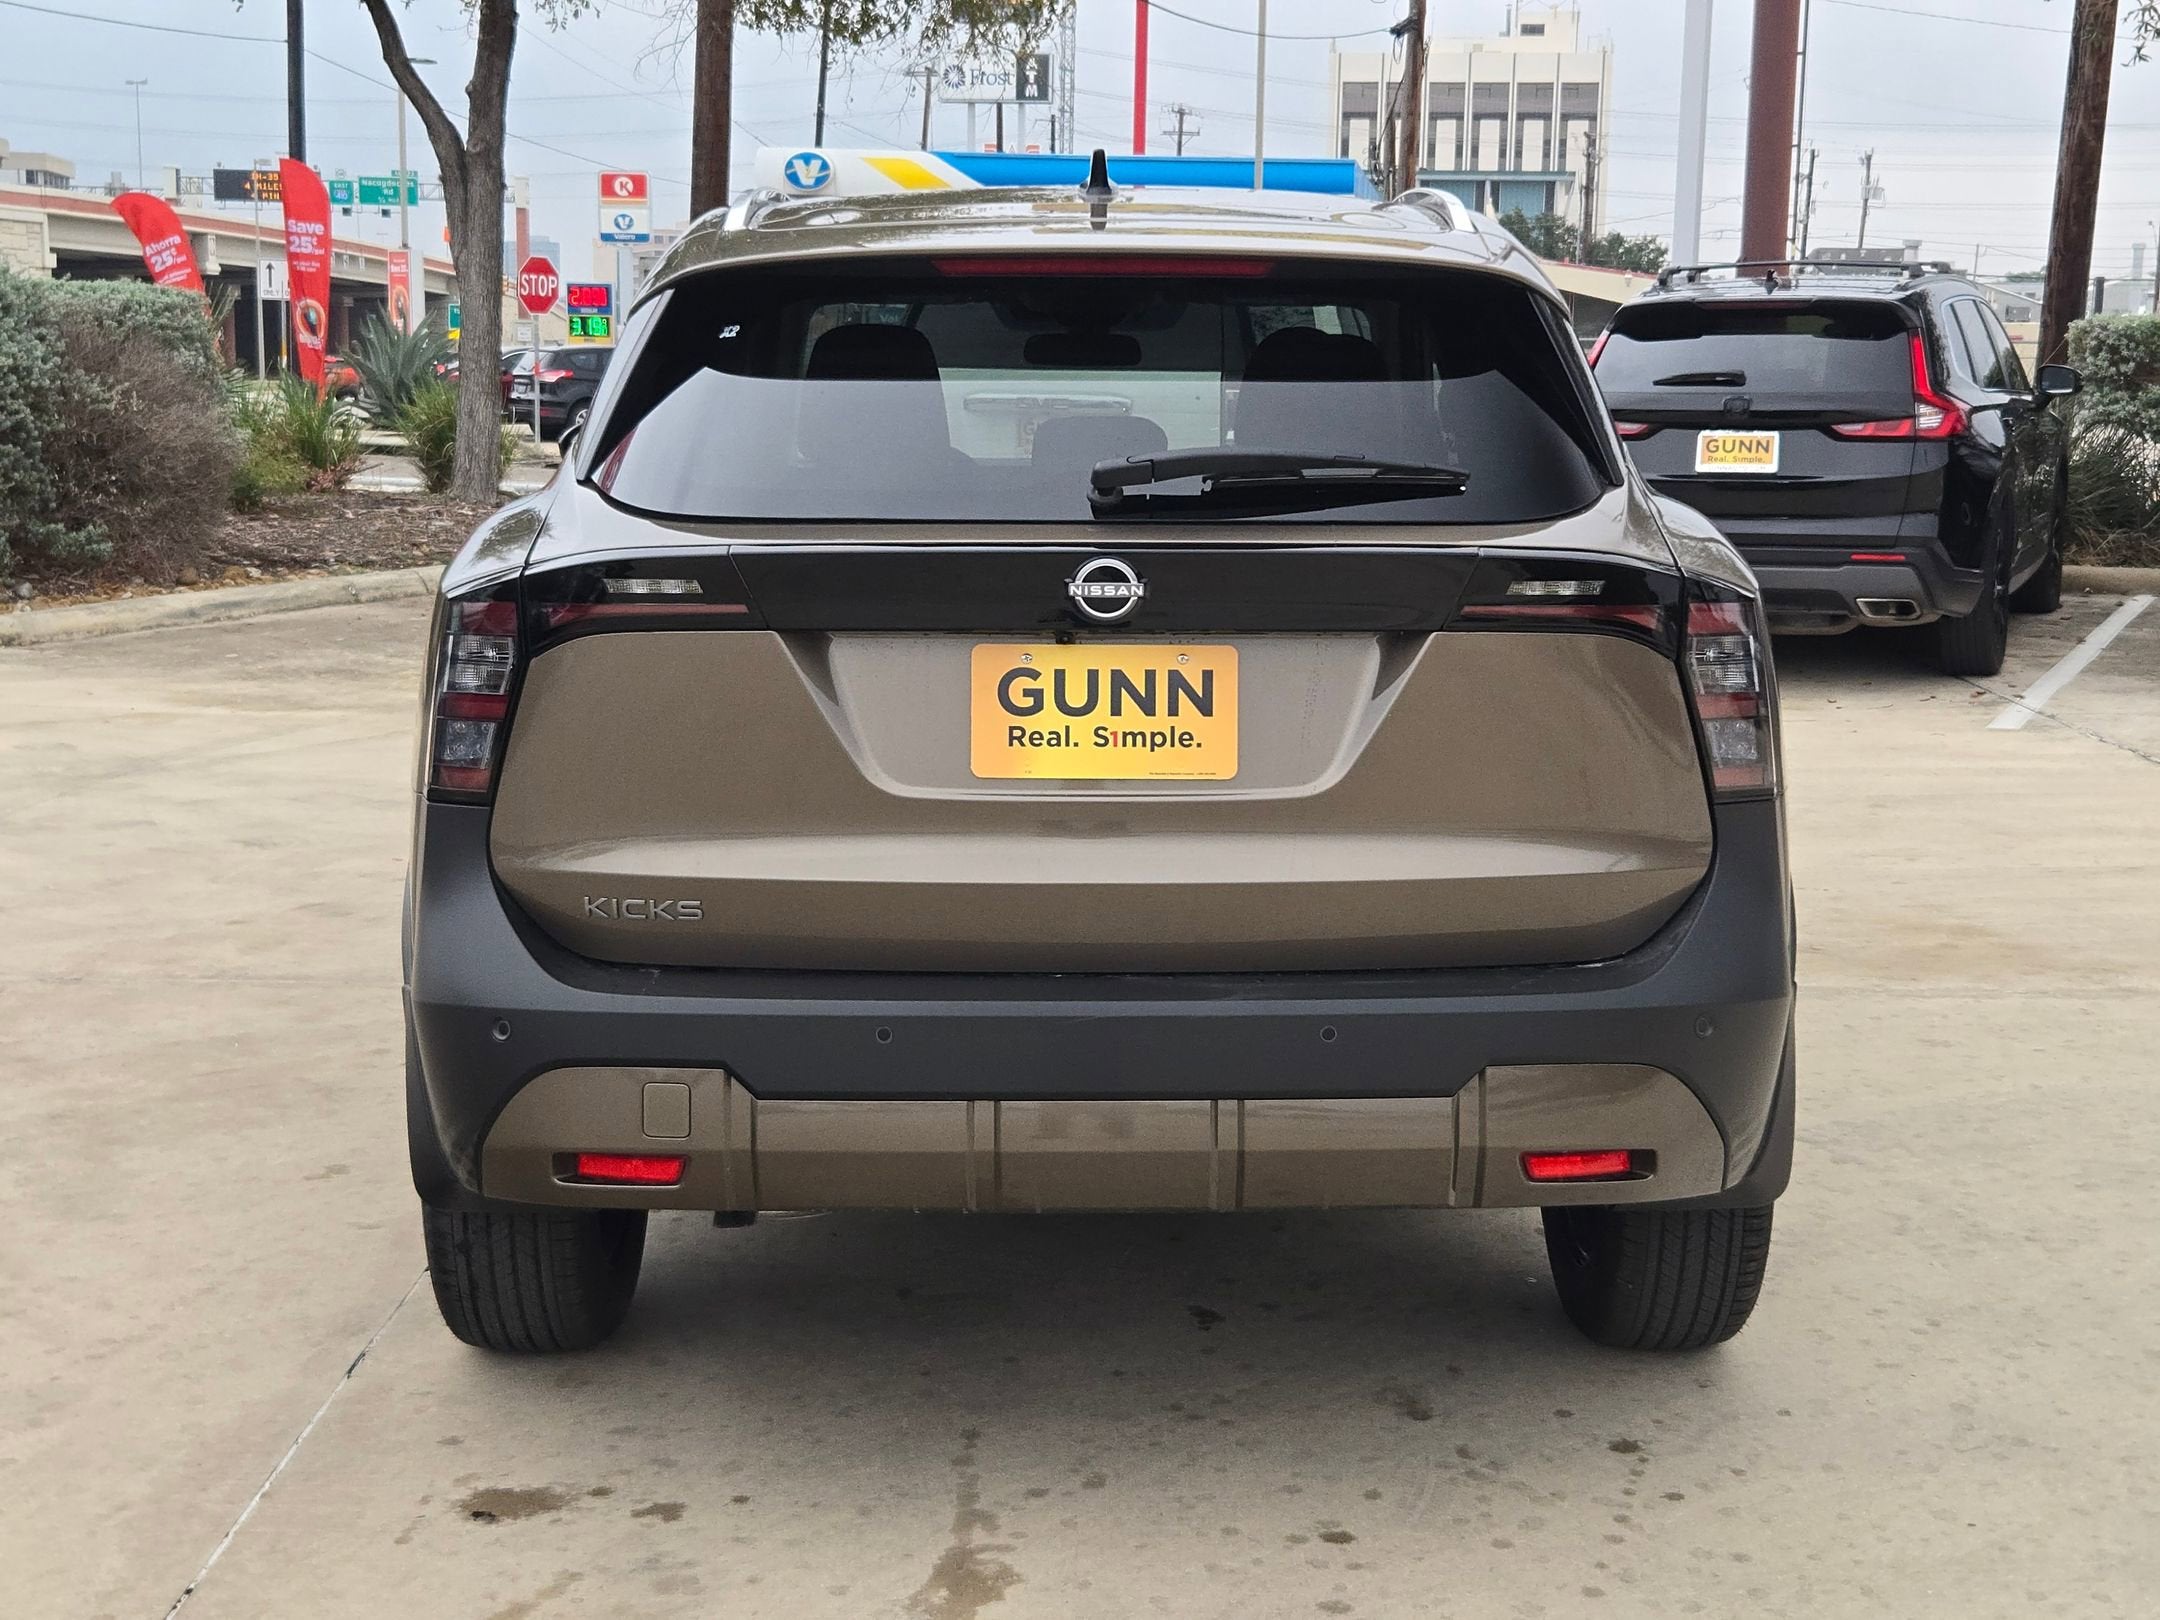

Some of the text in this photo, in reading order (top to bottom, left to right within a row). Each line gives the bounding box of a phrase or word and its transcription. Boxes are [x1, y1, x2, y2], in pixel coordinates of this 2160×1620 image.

[970, 68, 1014, 86] Frost
[1025, 57, 1039, 97] ATM
[361, 180, 414, 188] Nacogdoces
[287, 219, 325, 236] Save
[145, 235, 182, 257] Ahorra
[520, 274, 558, 297] STOP
[1705, 439, 1770, 453] GUNN
[1707, 455, 1729, 463] Real.
[1070, 585, 1143, 596] NISSAN
[997, 667, 1214, 717] GUNN
[1008, 725, 1079, 748] Real.
[583, 896, 704, 921] KICKS
